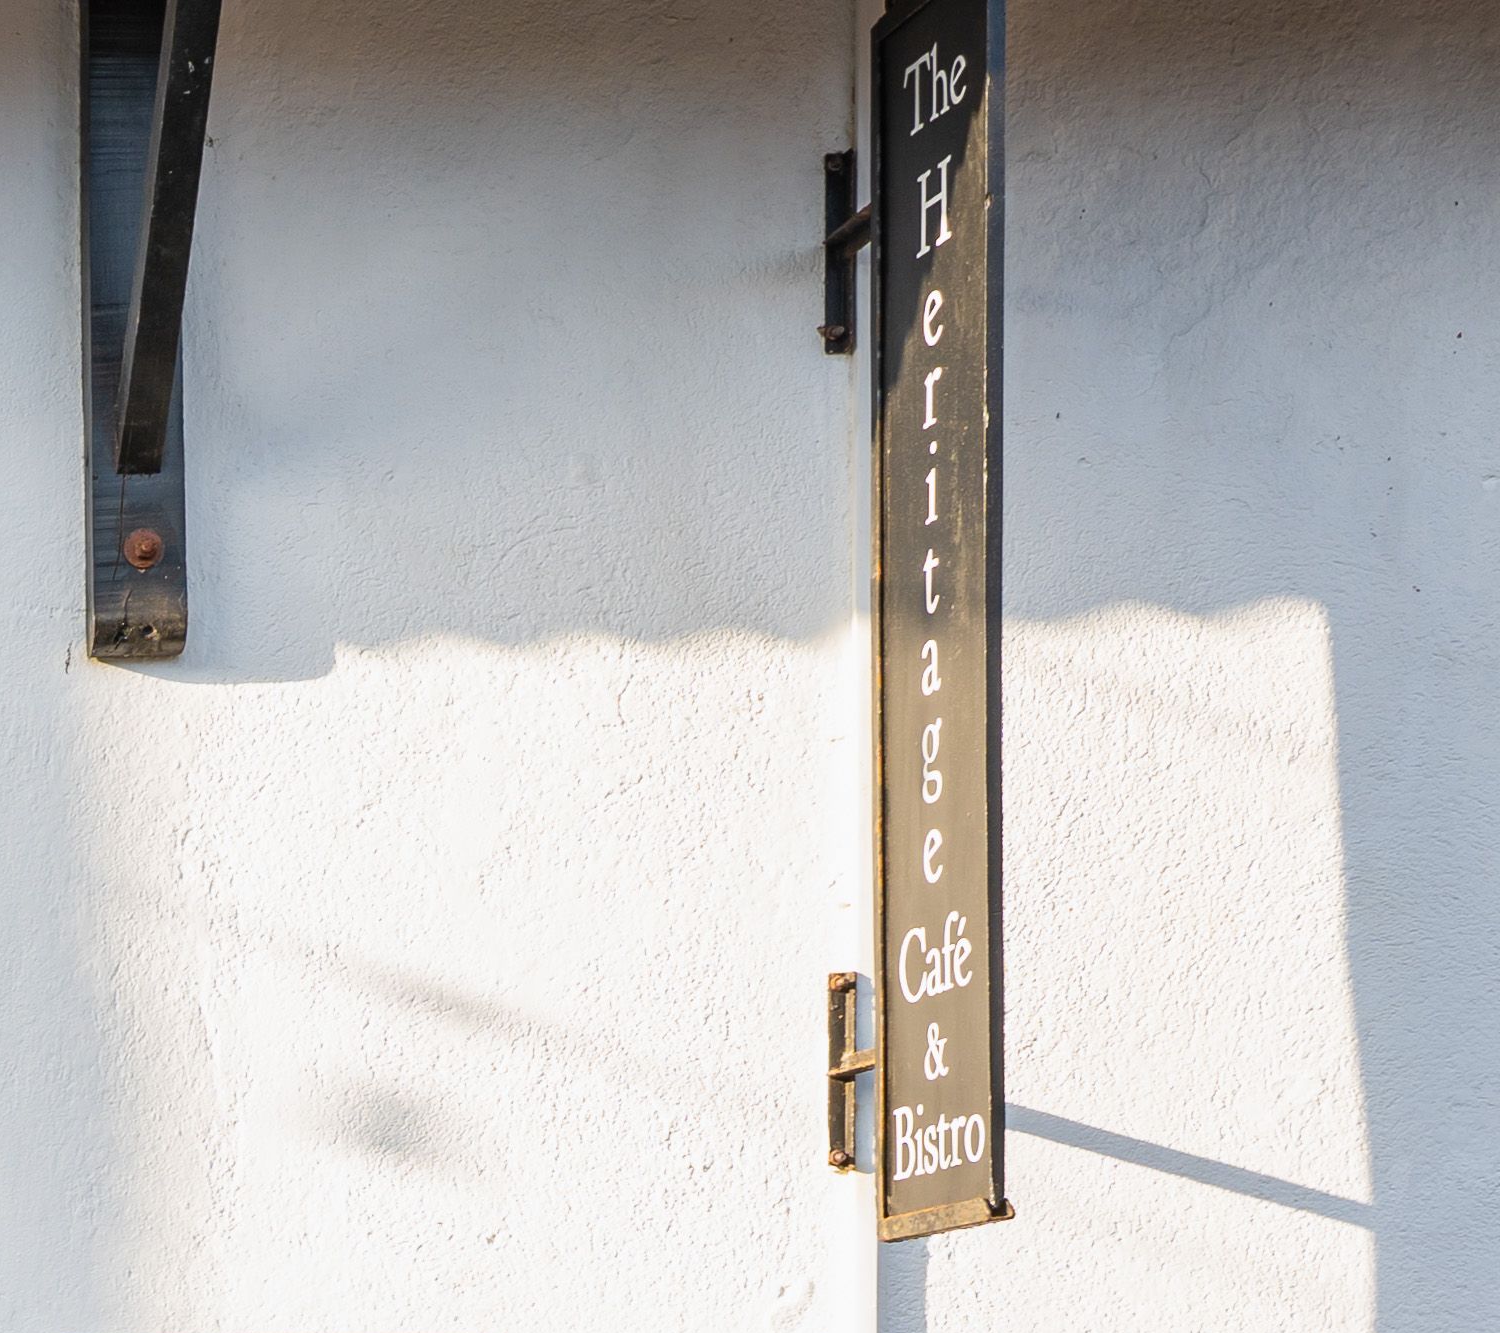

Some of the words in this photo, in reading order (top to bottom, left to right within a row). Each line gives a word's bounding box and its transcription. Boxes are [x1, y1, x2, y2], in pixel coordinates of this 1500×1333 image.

[902, 42, 967, 136] The
[899, 910, 974, 1004] Café
[923, 1022, 949, 1080] &
[892, 1105, 986, 1182] Bistro
